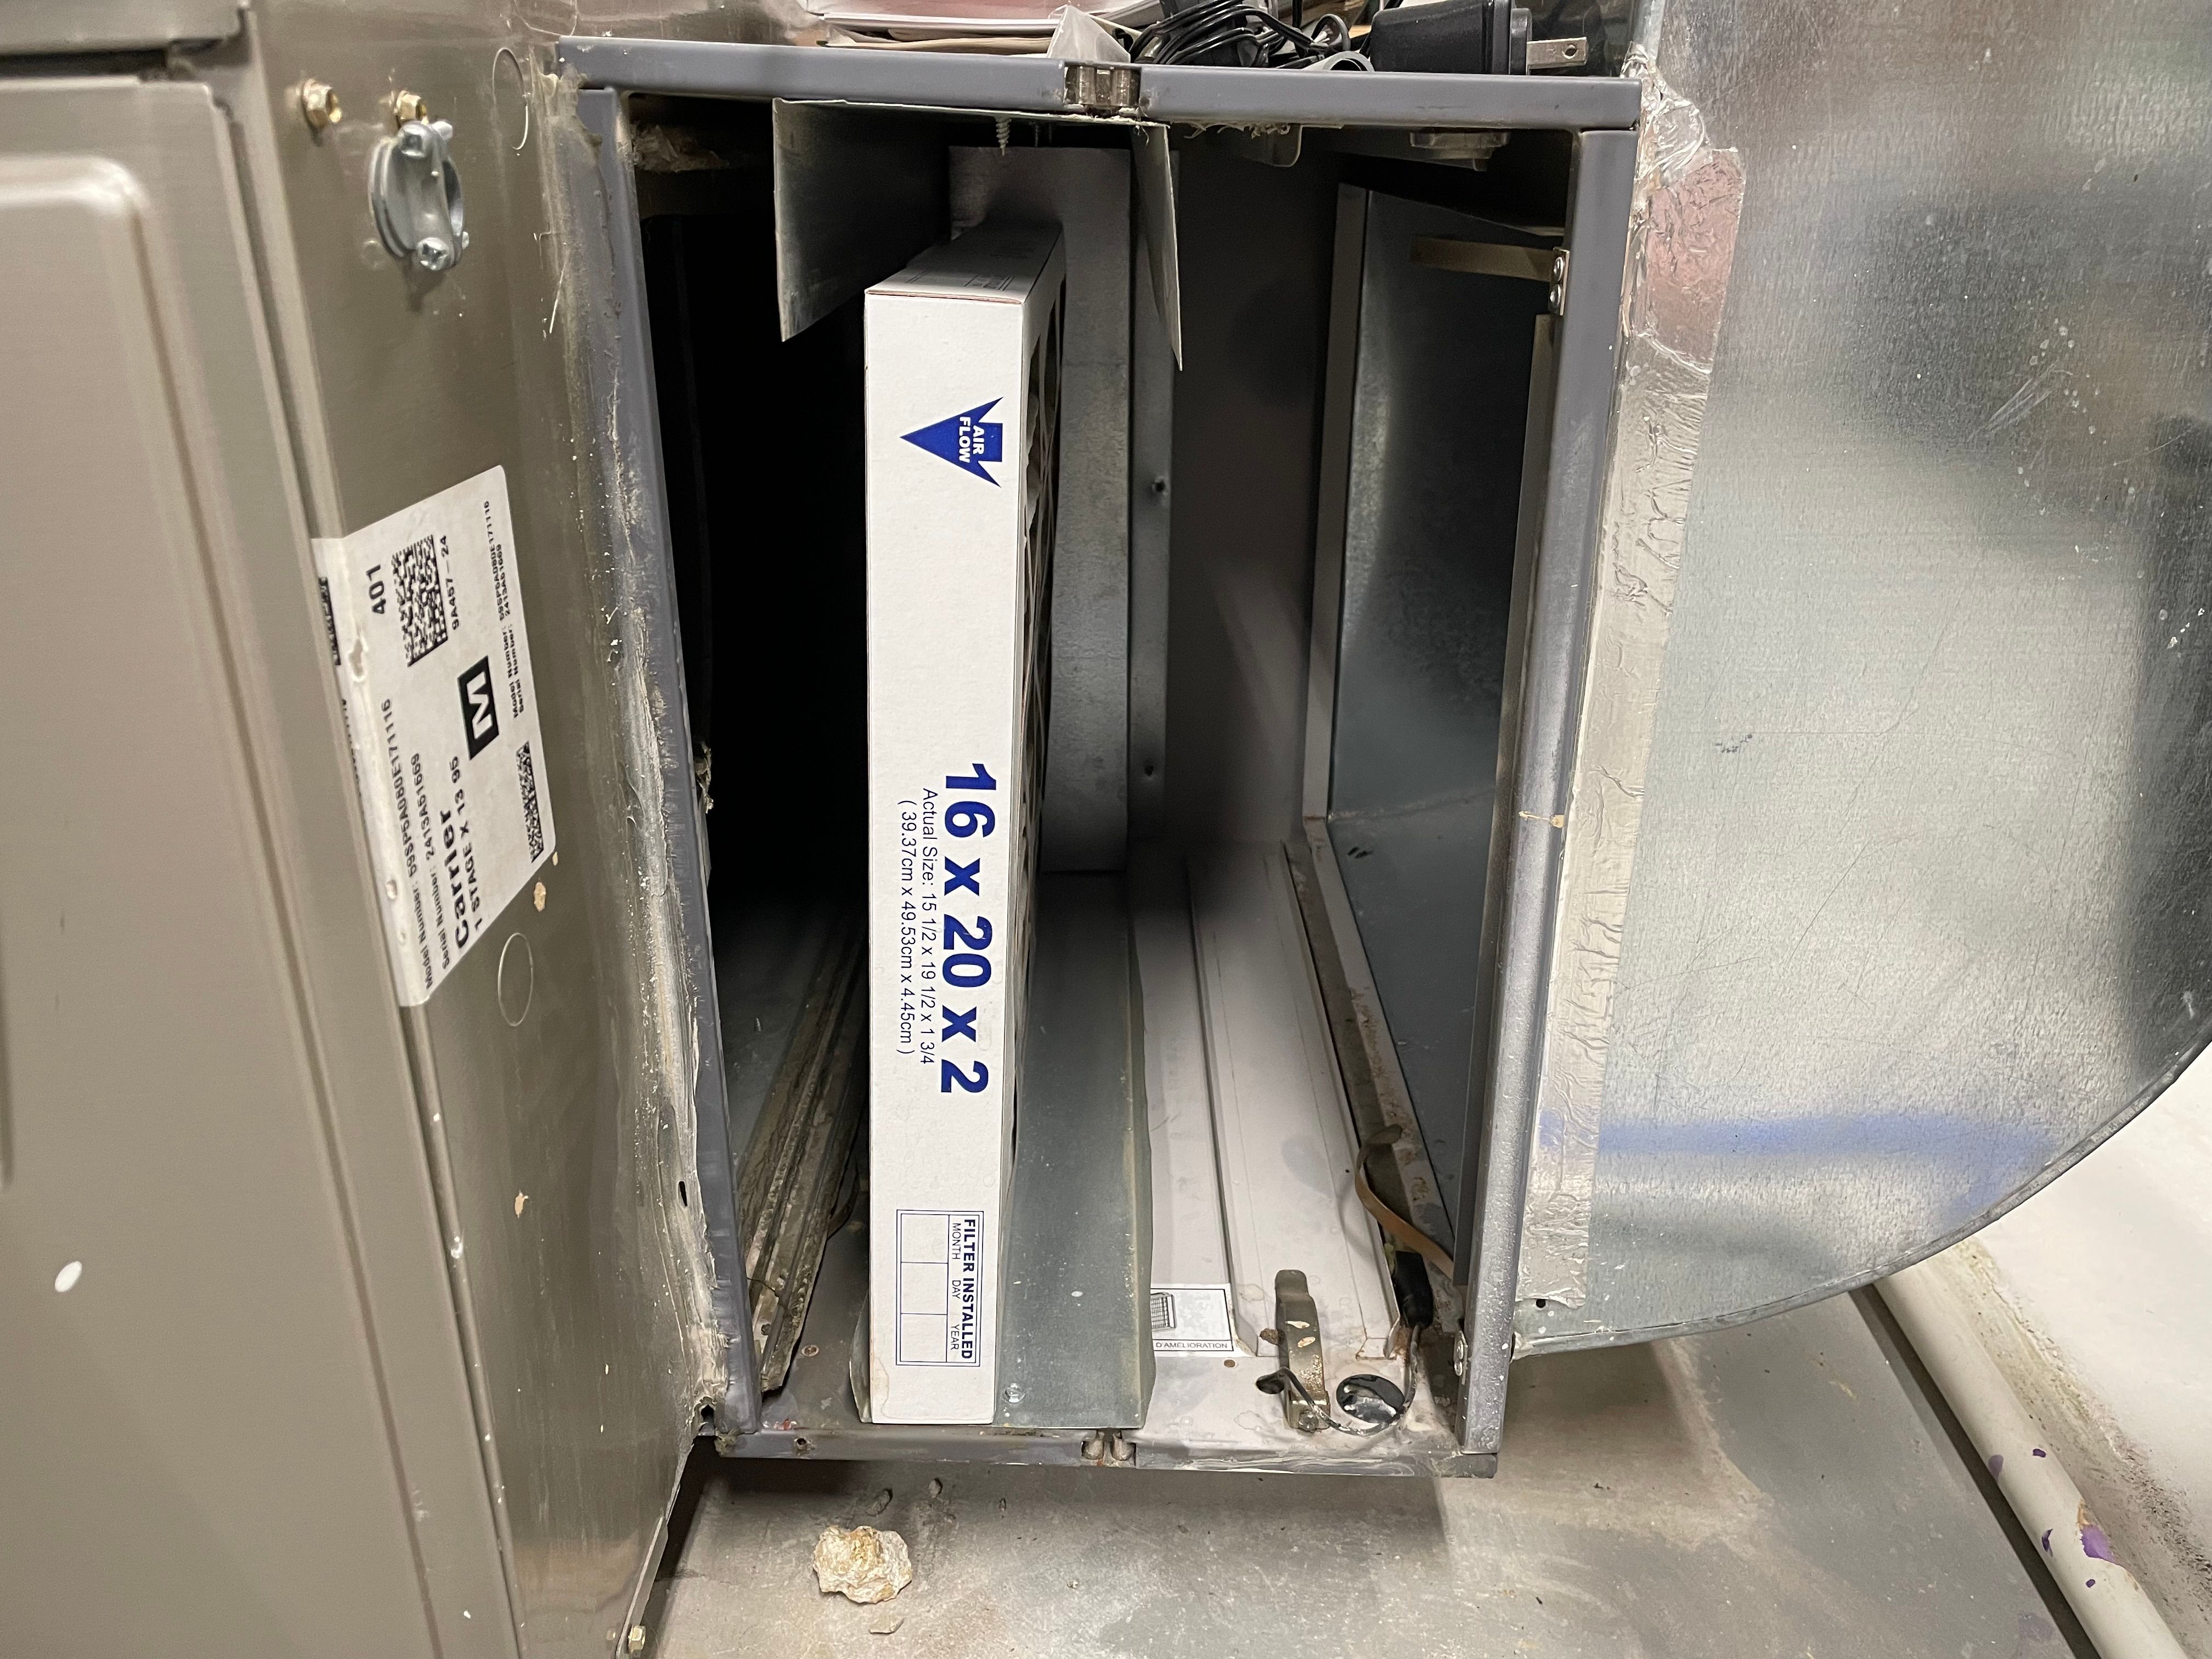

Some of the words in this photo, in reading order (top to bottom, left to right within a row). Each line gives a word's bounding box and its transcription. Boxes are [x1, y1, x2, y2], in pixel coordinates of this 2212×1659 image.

[959, 416, 970, 463] FLOW
[973, 425, 984, 455] AIR
[366, 564, 386, 614] 401
[466, 671, 493, 740] M
[509, 681, 518, 719] Model
[515, 679, 524, 713] Serial
[381, 699, 417, 877] 59SP5A080E171116
[449, 756, 460, 783] 95
[411, 753, 434, 860] 2413A51669
[455, 789, 465, 816] 13
[923, 788, 938, 840] Actual
[944, 763, 996, 838] 16
[460, 821, 469, 839] X
[440, 810, 469, 949] Carrier
[463, 842, 480, 912] STAGE
[922, 847, 938, 885] Size:
[944, 856, 980, 896] x
[430, 865, 443, 928] Number:
[901, 887, 912, 896] x
[922, 893, 936, 910] 15
[413, 881, 426, 945] Number:
[475, 918, 482, 930] 1
[921, 919, 936, 941] 1/2
[438, 928, 450, 969] Serial
[901, 901, 916, 968] 49.53cm
[922, 946, 933, 955] x
[943, 914, 992, 988] 20
[420, 945, 433, 989] Model
[901, 974, 912, 983] x
[921, 962, 936, 979] 19
[921, 986, 935, 1008] 1/2
[921, 1013, 932, 1022] x
[942, 1005, 977, 1042] x
[920, 1042, 935, 1064] 3/4
[941, 1059, 989, 1093] 2
[952, 1223, 961, 1260] MONTH
[963, 1219, 975, 1273] FILTER
[952, 1280, 961, 1299] DAY
[951, 1324, 960, 1350] YEAR
[961, 1278, 974, 1359] INSTALLED
